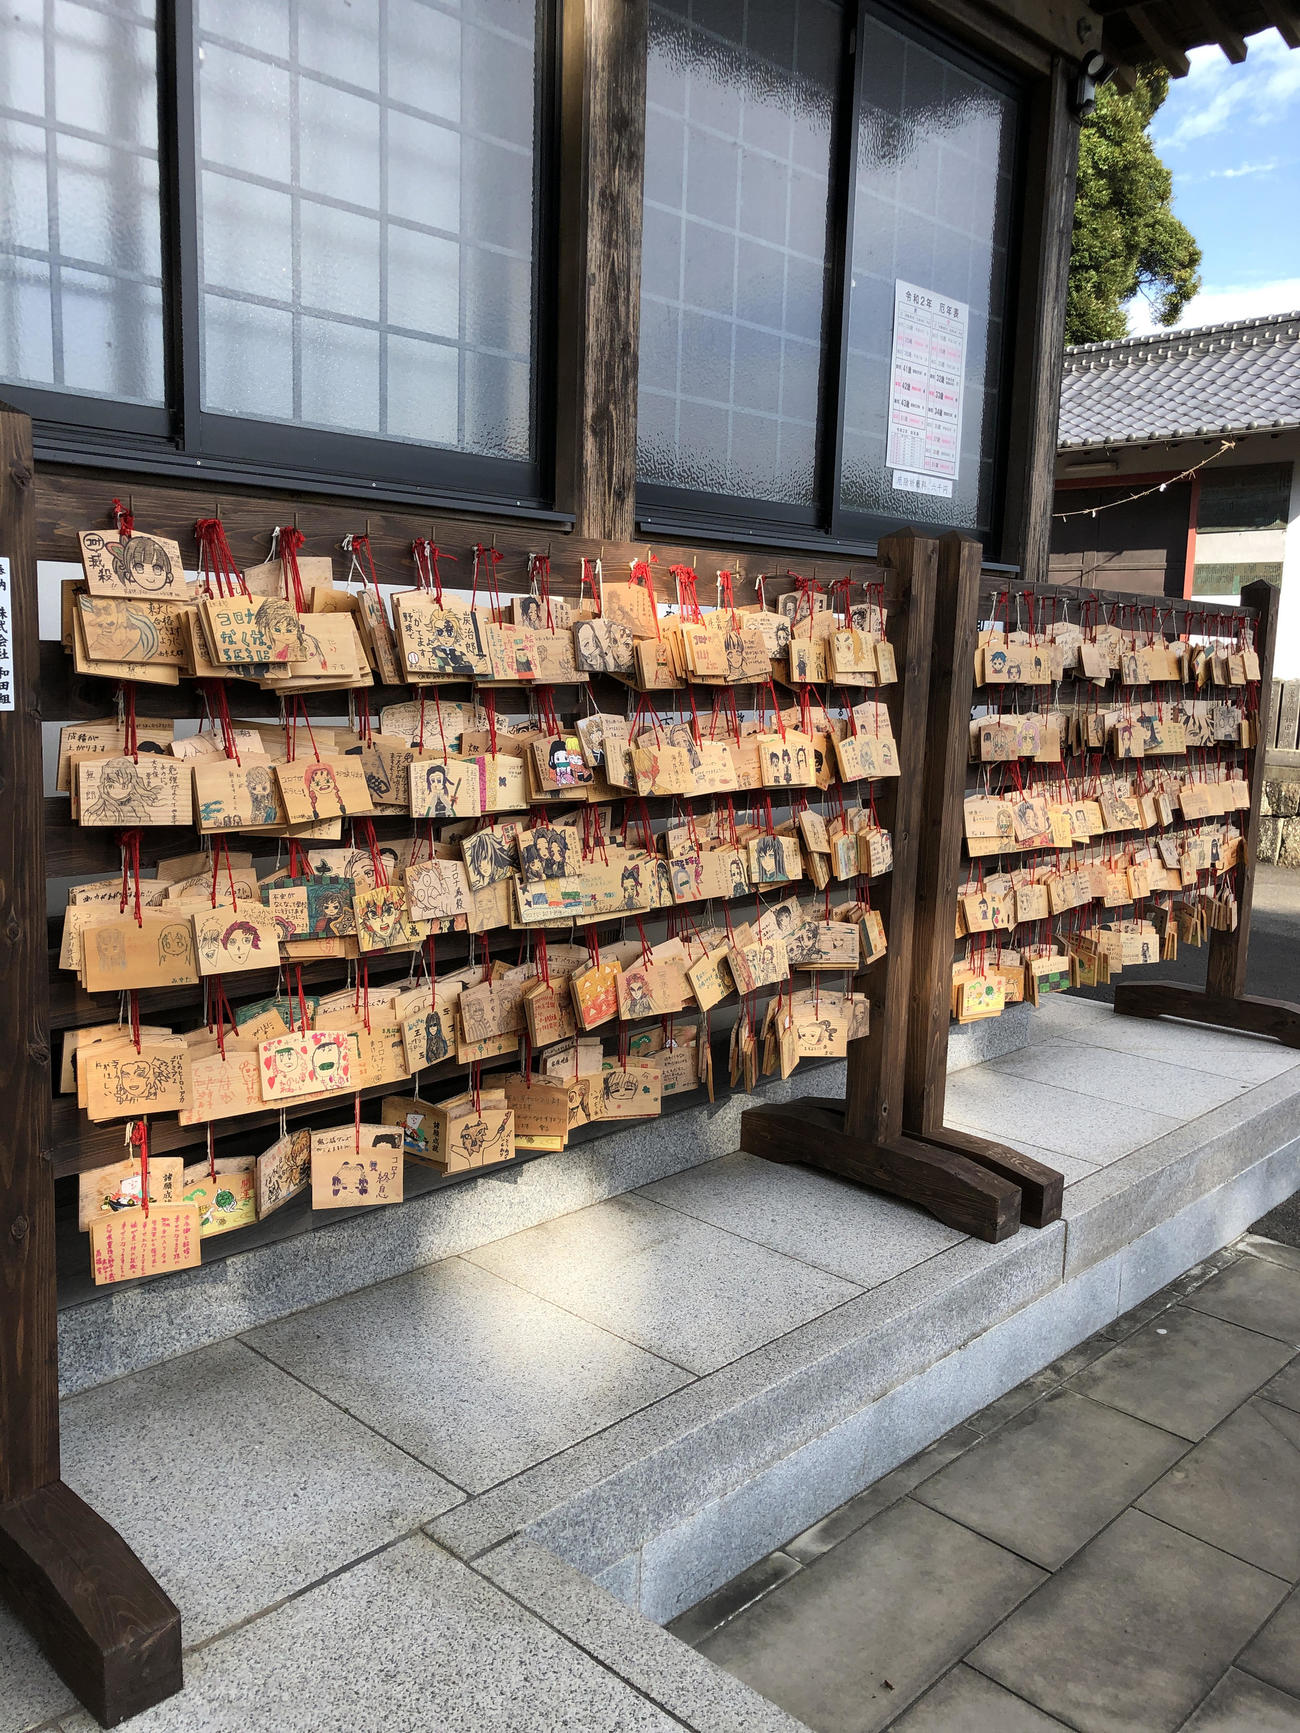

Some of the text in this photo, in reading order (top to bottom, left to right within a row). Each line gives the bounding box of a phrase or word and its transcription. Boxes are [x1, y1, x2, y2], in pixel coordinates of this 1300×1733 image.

[905, 290, 959, 319] 令和2年 厄年表
[463, 611, 477, 656] 炭治郎
[163, 1173, 173, 1202] 諸願成
[376, 1171, 391, 1199] 終息
